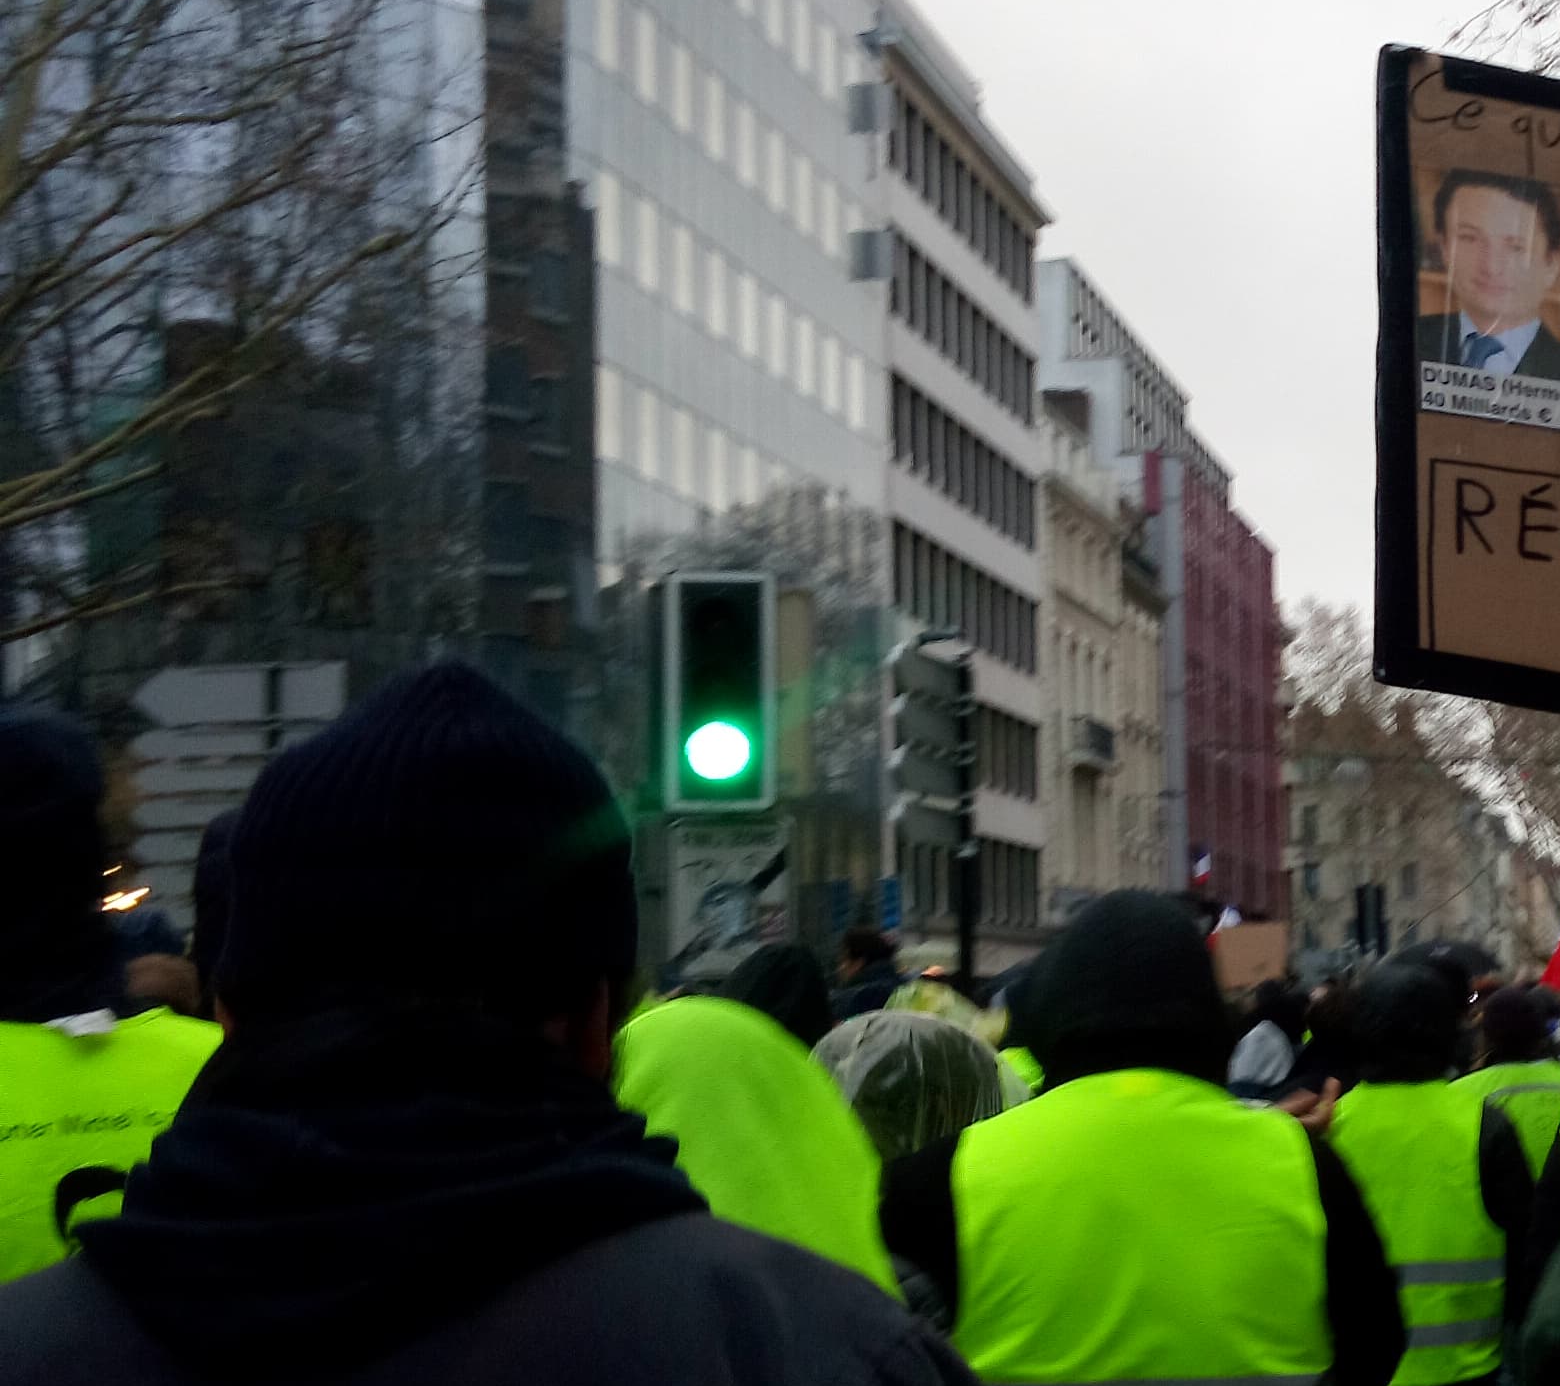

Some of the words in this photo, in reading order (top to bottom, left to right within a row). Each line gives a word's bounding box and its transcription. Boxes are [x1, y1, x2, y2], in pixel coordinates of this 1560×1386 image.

[1409, 70, 1485, 131] Ce
[1422, 366, 1496, 391] DUMAS
[1423, 390, 1446, 408] 40
[1451, 394, 1532, 420] Milliards
[1538, 407, 1553, 424] €
